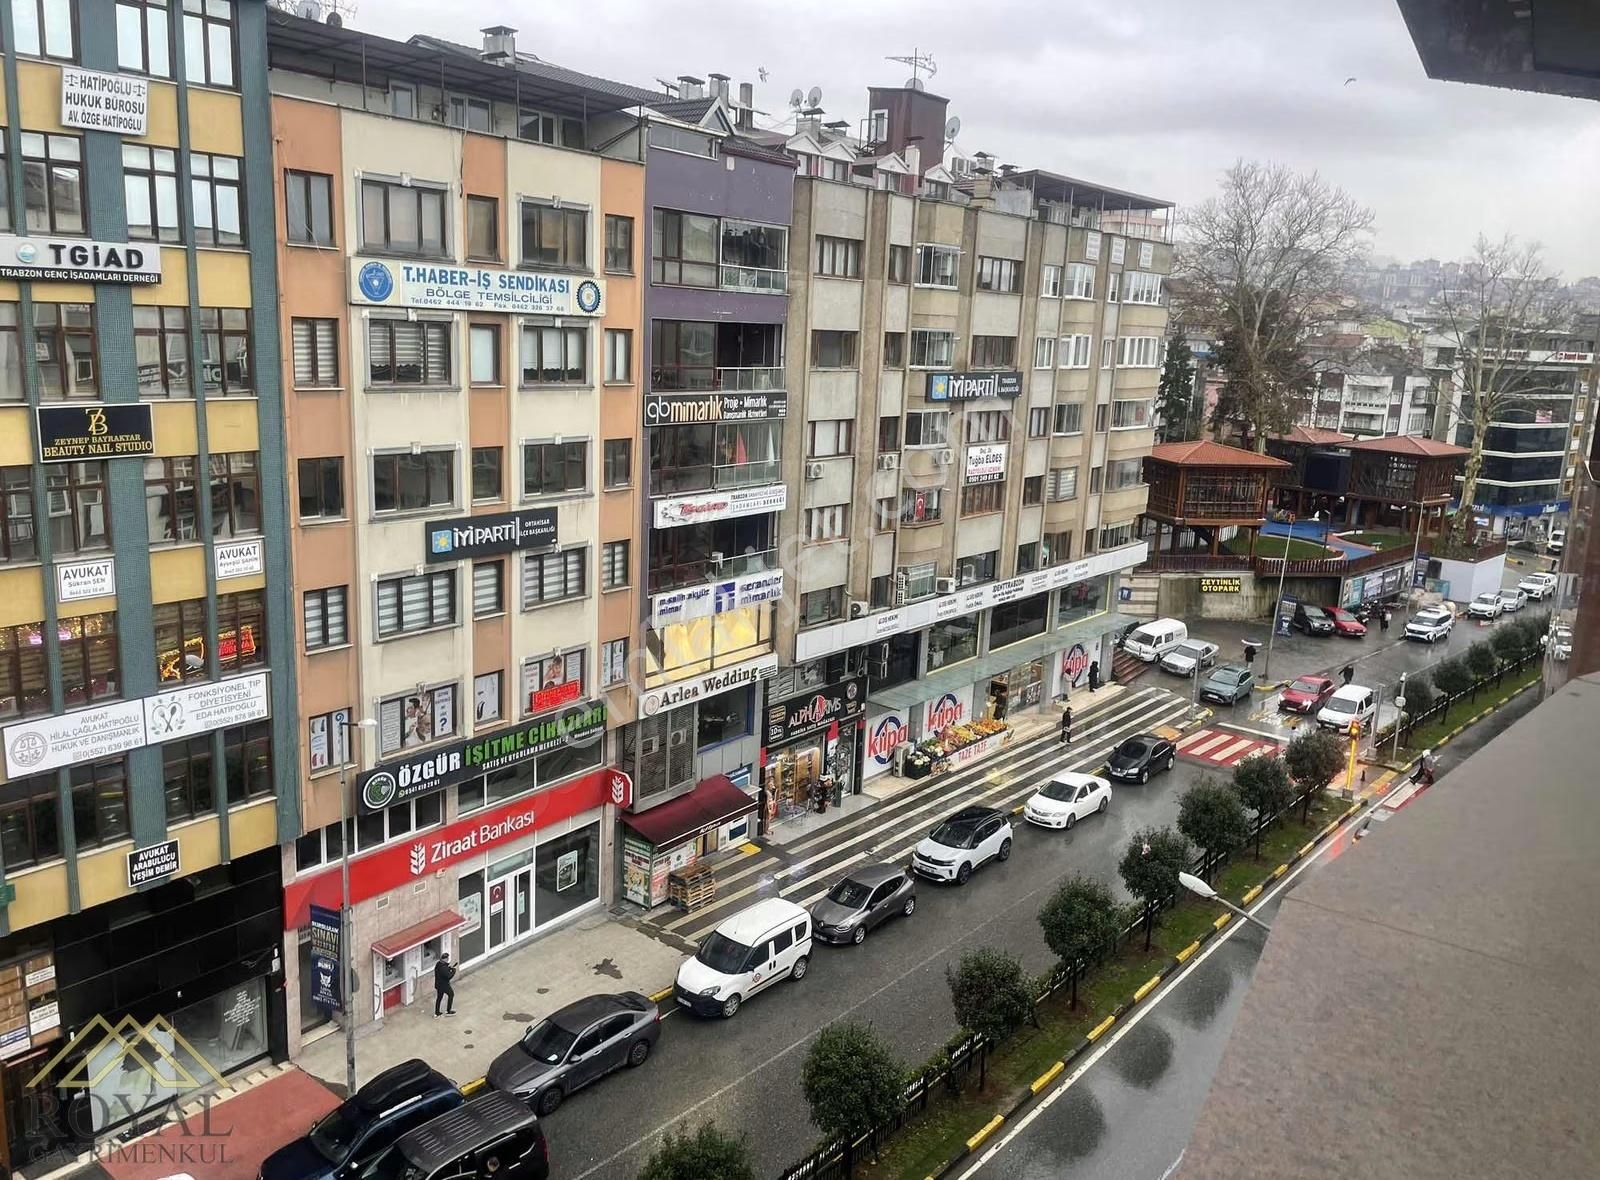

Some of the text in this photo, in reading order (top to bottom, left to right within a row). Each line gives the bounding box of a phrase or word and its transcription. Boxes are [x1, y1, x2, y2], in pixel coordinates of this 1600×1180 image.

[80, 75, 132, 96] HATİPOĞLU
[66, 92, 145, 115] HUKUK BÜROSU
[68, 109, 142, 130] AV. ÖZGE HATİPOĞLU
[0, 268, 159, 283] TRABZON GENÇ İŞADAMLARI DERNEĞİ
[499, 274, 570, 294] SENDİKASI
[426, 286, 553, 305] BÖLGE TEMSİLCİLİĞİ
[671, 395, 723, 422] mimarlık
[724, 396, 739, 411] Proje
[43, 440, 153, 457] BEAUTY NAIL STUDIO
[54, 434, 141, 446] ZEYNEP BAYRAKTAR
[219, 546, 257, 560] AVUKAT
[63, 565, 109, 580] AVUKAT
[1201, 577, 1240, 586] ZEYTİNLİK
[188, 679, 261, 700] FONKSİYONEL TIP
[660, 687, 699, 707] Arlea
[703, 667, 758, 693] Wedding
[200, 690, 252, 708] DİYETİSYENİ
[80, 712, 109, 724] AVUKAT
[196, 711, 213, 720] EDA
[928, 699, 963, 732] kipa
[50, 729, 71, 741] HİLAL
[51, 726, 140, 753] HUKUK VE DANIŞMANLIK
[465, 704, 608, 767] İŞİTME CİHAZLARI
[868, 719, 908, 758] kipa
[398, 752, 461, 788] ÖZGÜR
[430, 809, 535, 864] Ziraat Bankası
[133, 852, 176, 872] ARABULUCU
[139, 845, 169, 861] AVUKAT
[131, 861, 178, 882] YEŞİM DEMİR
